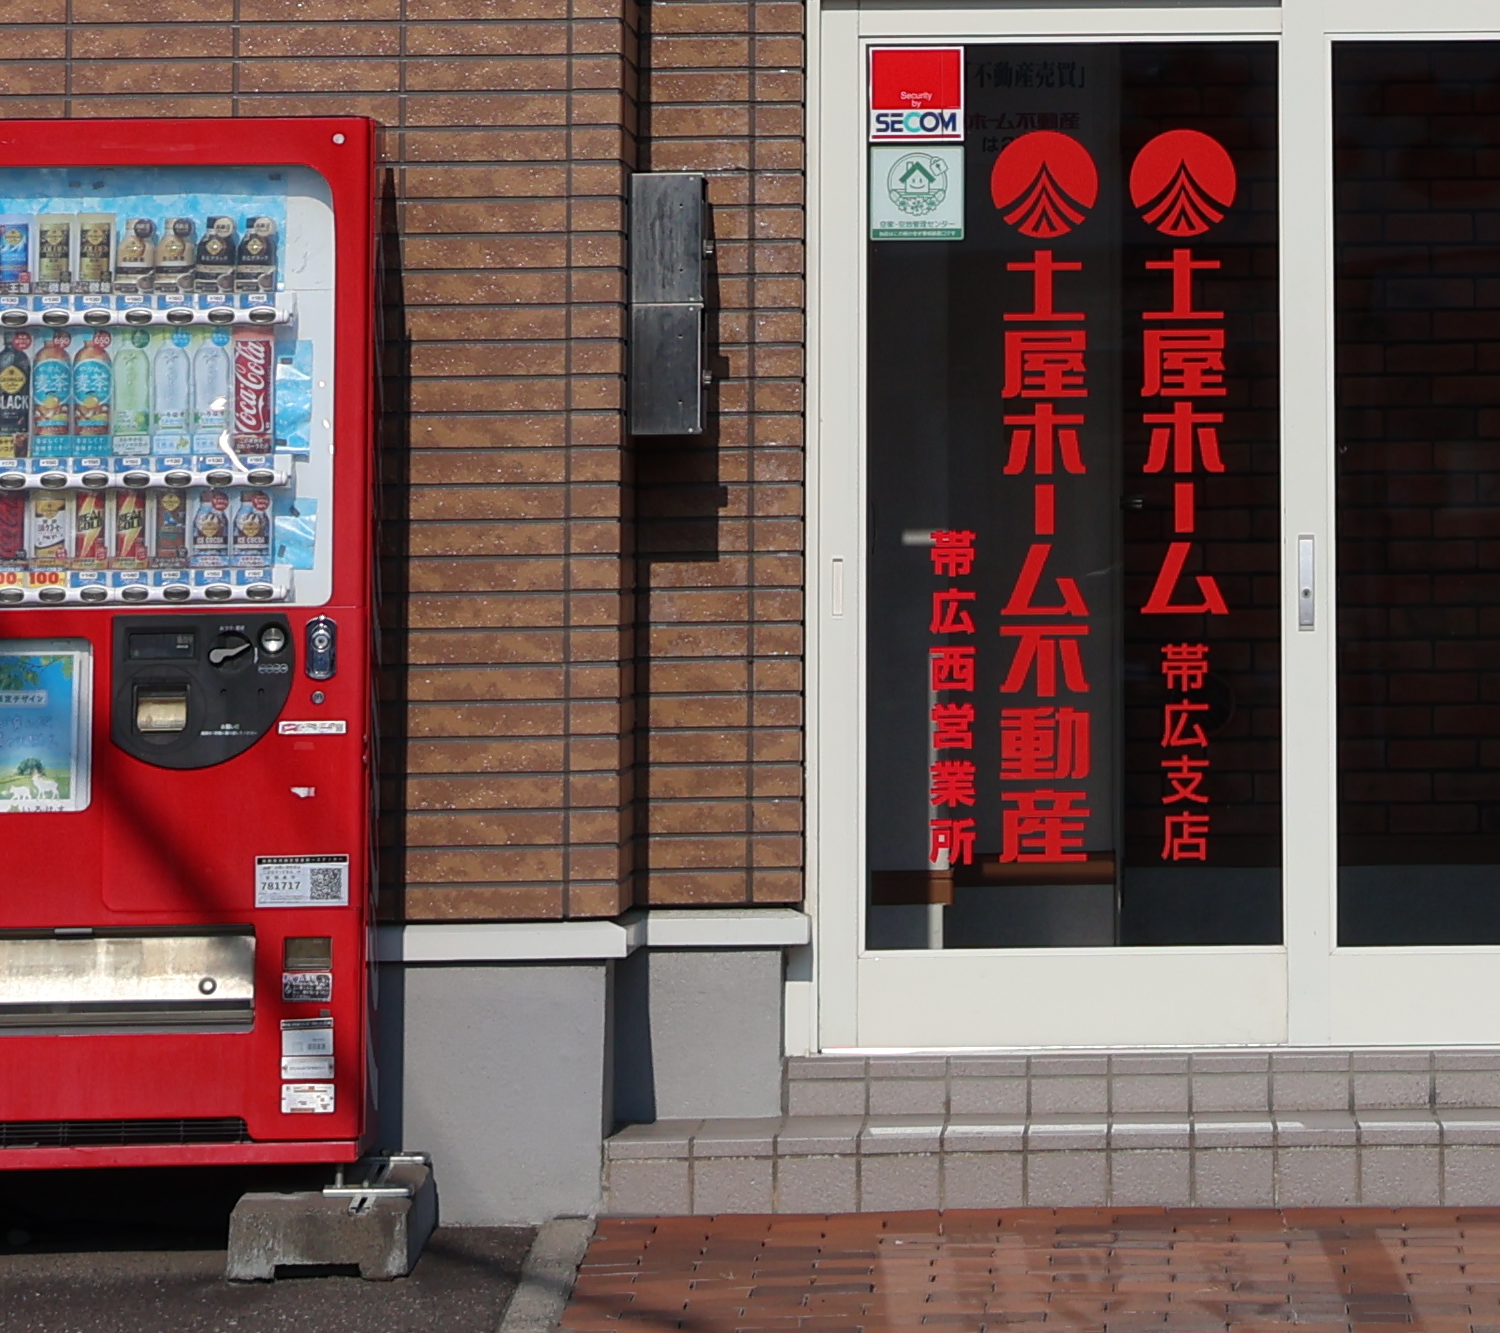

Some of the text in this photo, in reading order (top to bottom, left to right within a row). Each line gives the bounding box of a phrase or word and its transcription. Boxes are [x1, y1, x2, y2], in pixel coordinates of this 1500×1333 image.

[875, 111, 957, 133] SECOM
[900, 91, 932, 101] Security
[911, 100, 922, 108] by
[1140, 248, 1229, 616] 土屋ホーム
[999, 248, 1090, 864] 土屋ホーム不動産
[929, 530, 975, 866] 帯広西営業所
[1160, 642, 1210, 862] 帯広支店
[261, 881, 301, 891] 781717
